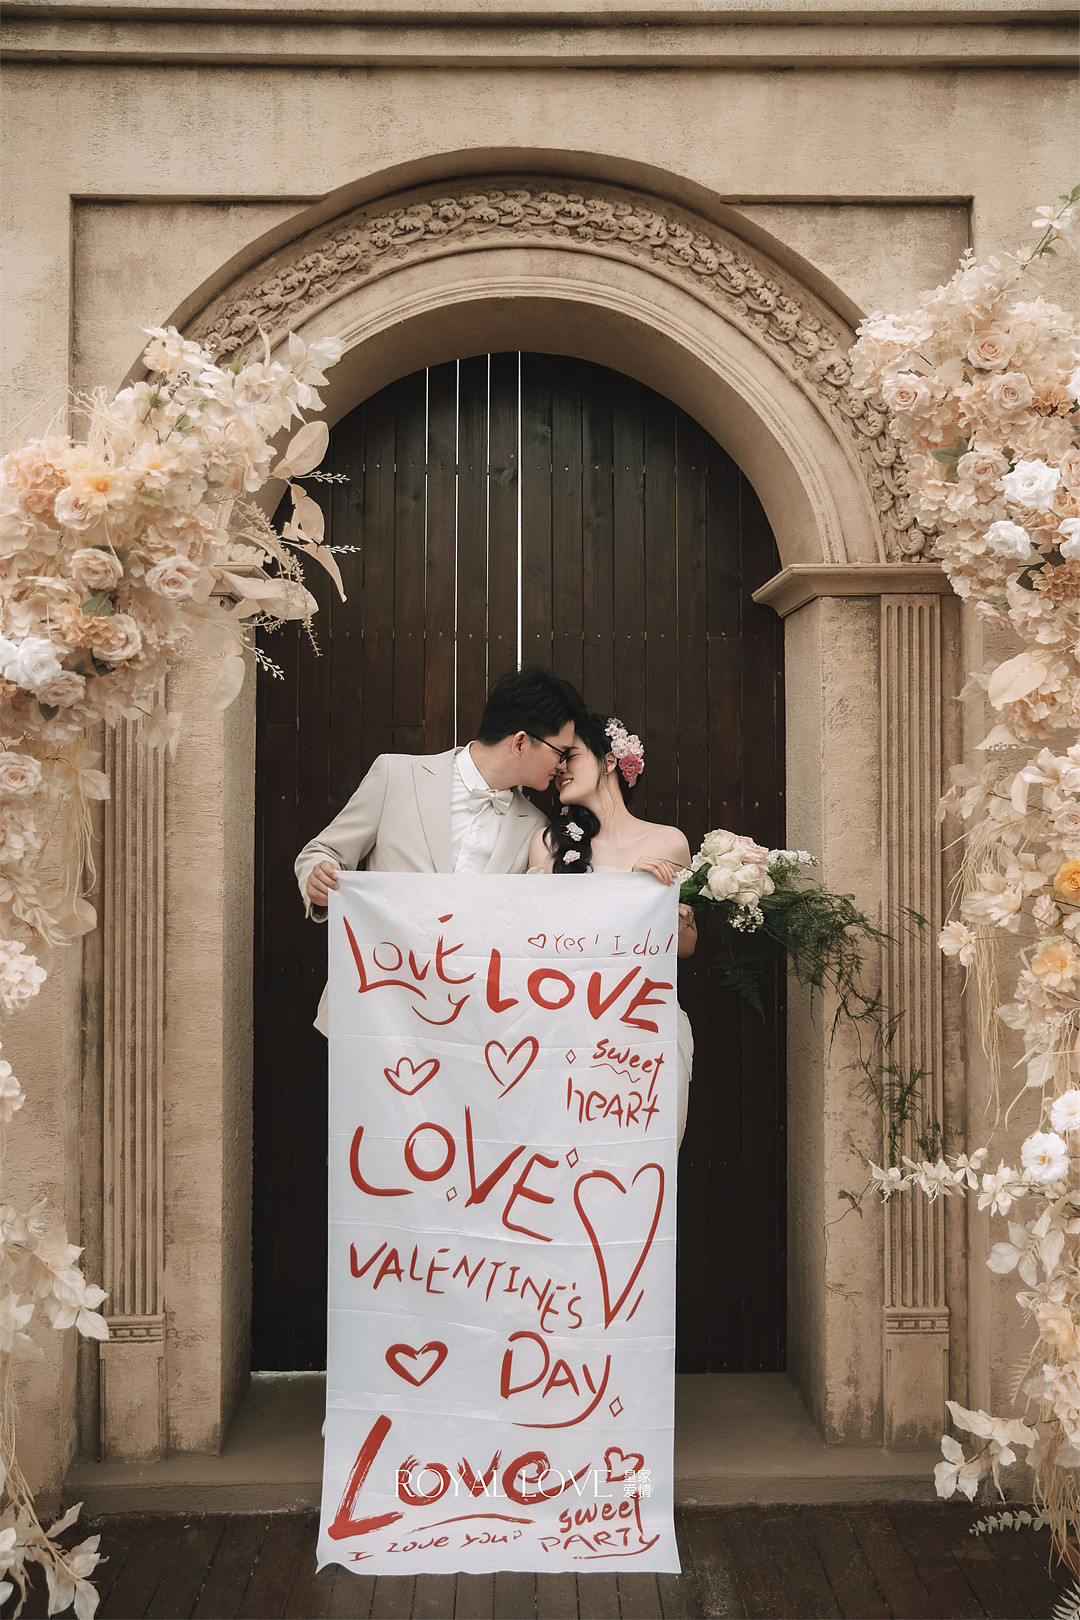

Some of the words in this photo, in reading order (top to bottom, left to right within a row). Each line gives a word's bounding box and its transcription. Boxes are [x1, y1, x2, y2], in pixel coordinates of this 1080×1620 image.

[611, 935, 627, 956] I
[486, 947, 674, 1034] LOVE
[592, 1038, 665, 1103] sweet
[349, 1105, 560, 1243] LOVE
[348, 1551, 374, 1562] I
